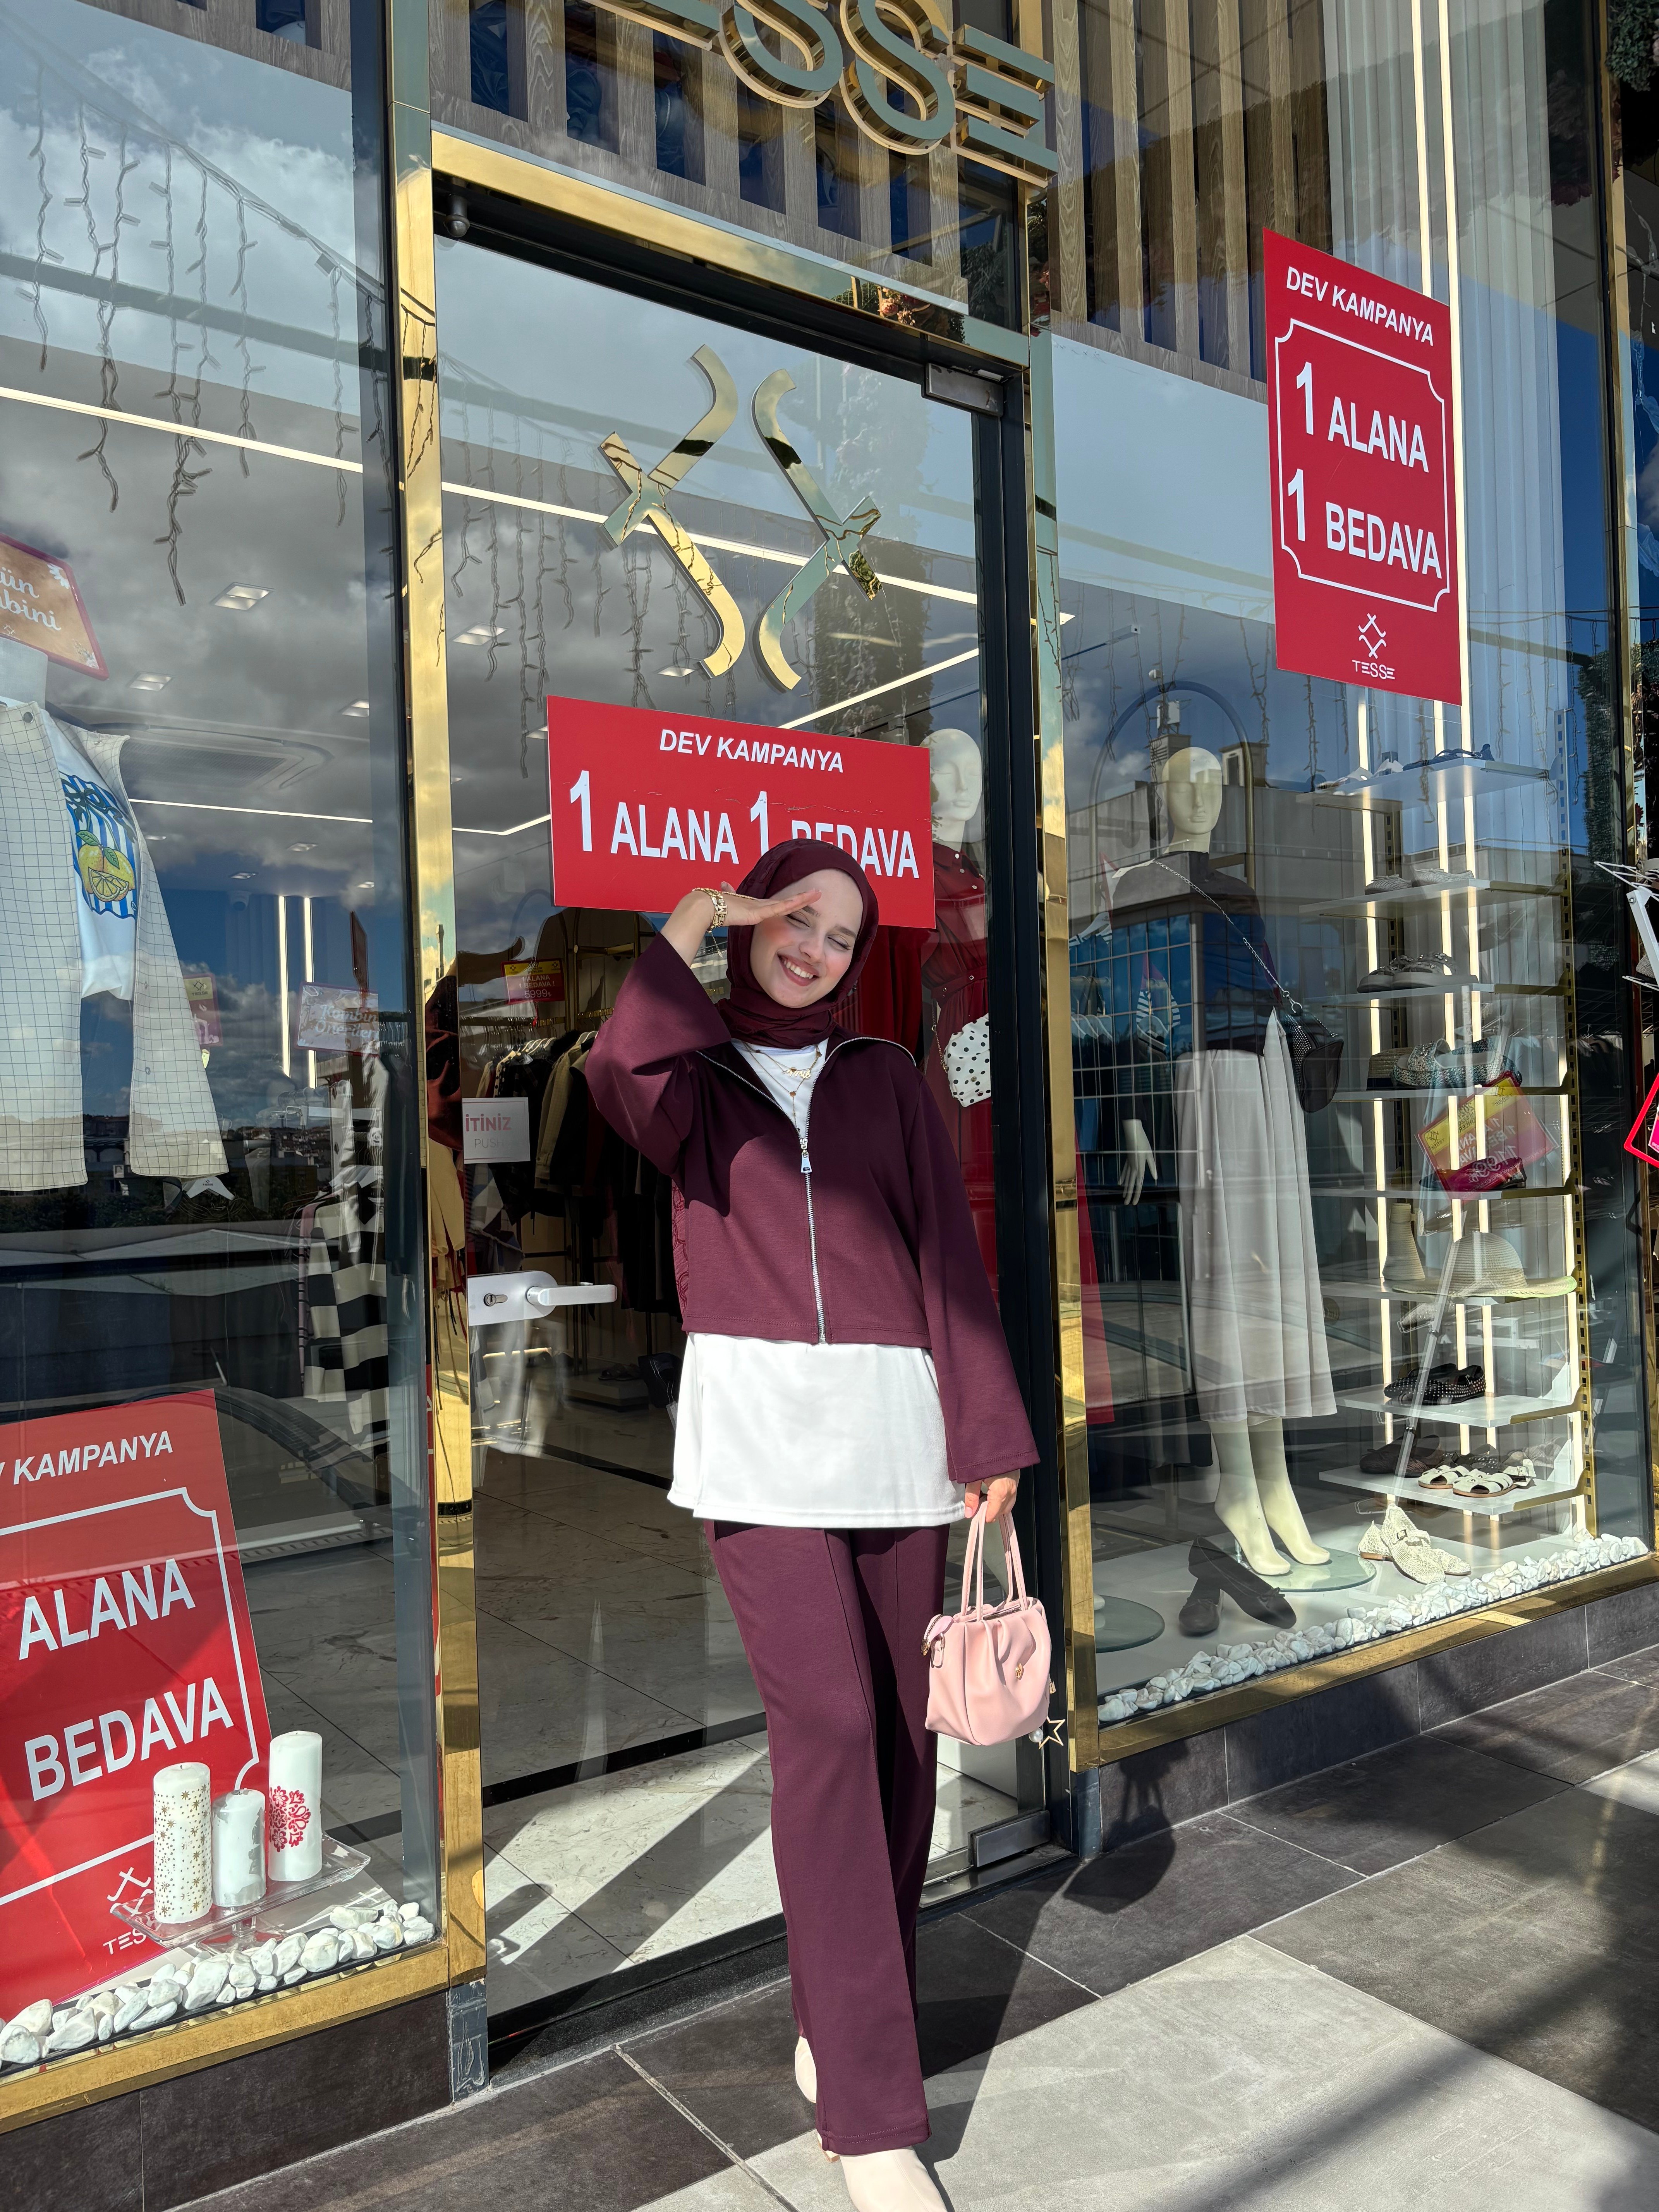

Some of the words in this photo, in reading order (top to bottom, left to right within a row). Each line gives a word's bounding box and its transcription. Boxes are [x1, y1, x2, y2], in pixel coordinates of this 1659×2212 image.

[602, 0, 1059, 187] SSE
[1286, 266, 1328, 301] DEV
[1332, 285, 1434, 346] KAMPANYA
[1296, 361, 1314, 435] 1
[1328, 396, 1429, 473] ALANA
[1288, 468, 1305, 542] 1
[1326, 501, 1442, 579] BEDAVA
[1352, 659, 1395, 680] TESSE
[659, 729, 712, 756] DEV
[717, 737, 843, 773] KAMPANYA
[570, 770, 592, 852] 1
[610, 802, 739, 864] ALANA
[750, 791, 769, 857] 1
[320, 1005, 378, 1022] Kombin
[466, 1113, 512, 1132] İTİNİZ
[475, 1138, 503, 1148] PUSH
[14, 1431, 173, 1485] KAMPANYA
[19, 1558, 196, 1661] ALANA
[24, 1677, 234, 1802] BEDAVA
